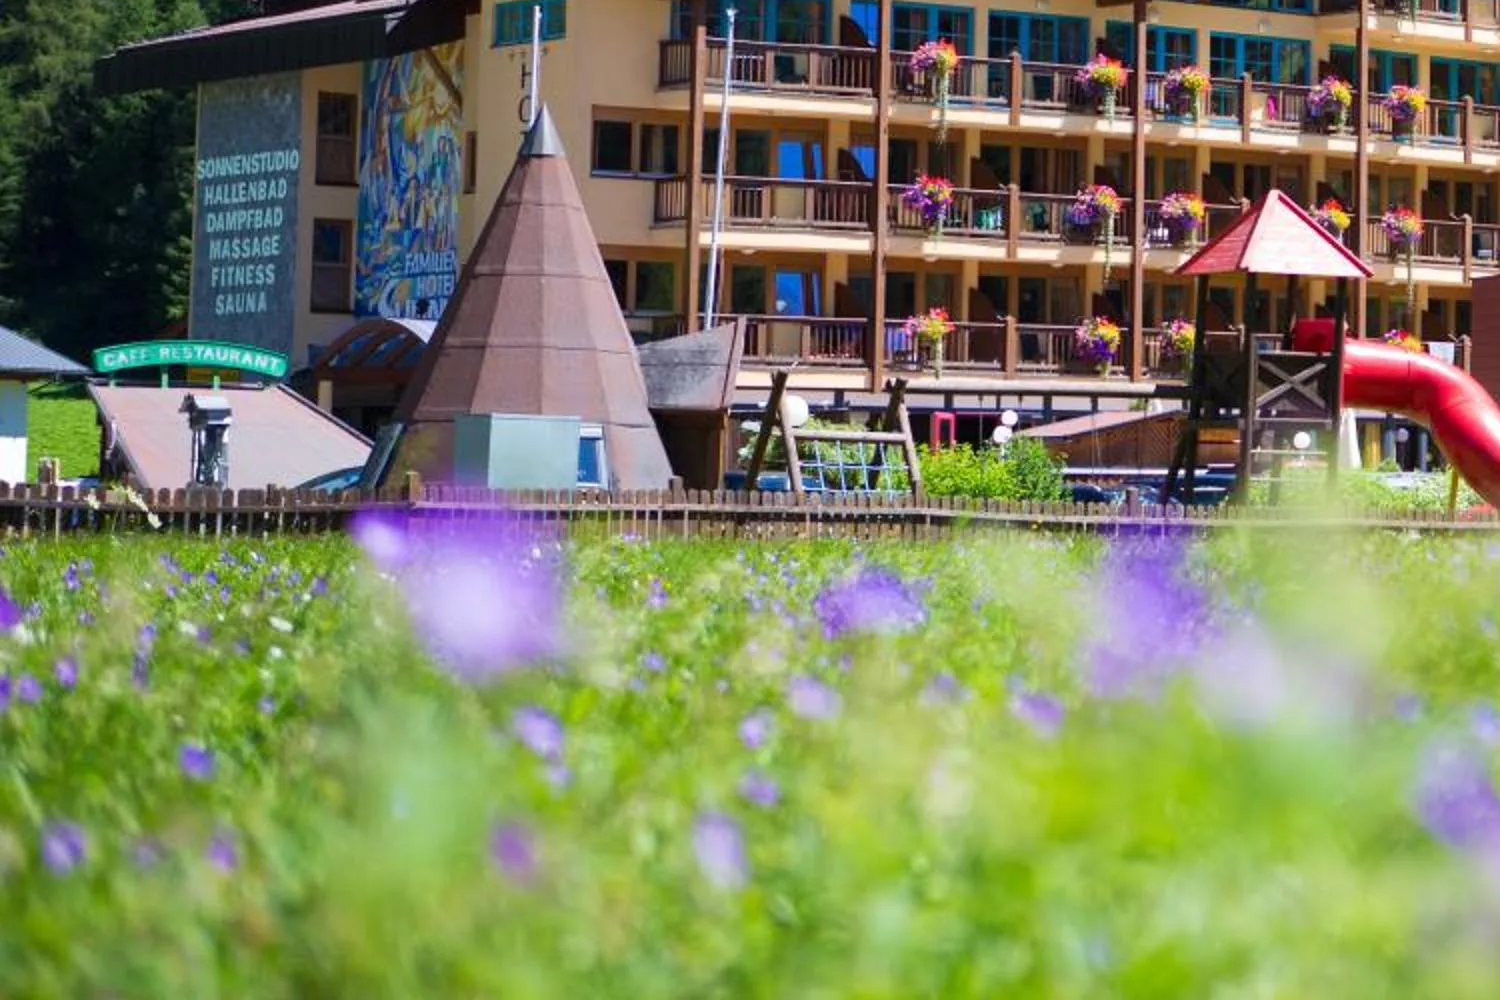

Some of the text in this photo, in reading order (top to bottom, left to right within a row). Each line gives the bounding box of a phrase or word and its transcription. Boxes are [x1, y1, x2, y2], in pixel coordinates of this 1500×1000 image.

[197, 150, 299, 179] SONNENSTUDIO
[204, 179, 287, 205] HALLENBAD
[206, 207, 283, 233] DAMPFBAD
[209, 235, 280, 261] MASSAGE
[211, 263, 275, 288] FITNESS
[215, 291, 268, 316] SAUNA
[160, 345, 279, 370] RESTAURANT
